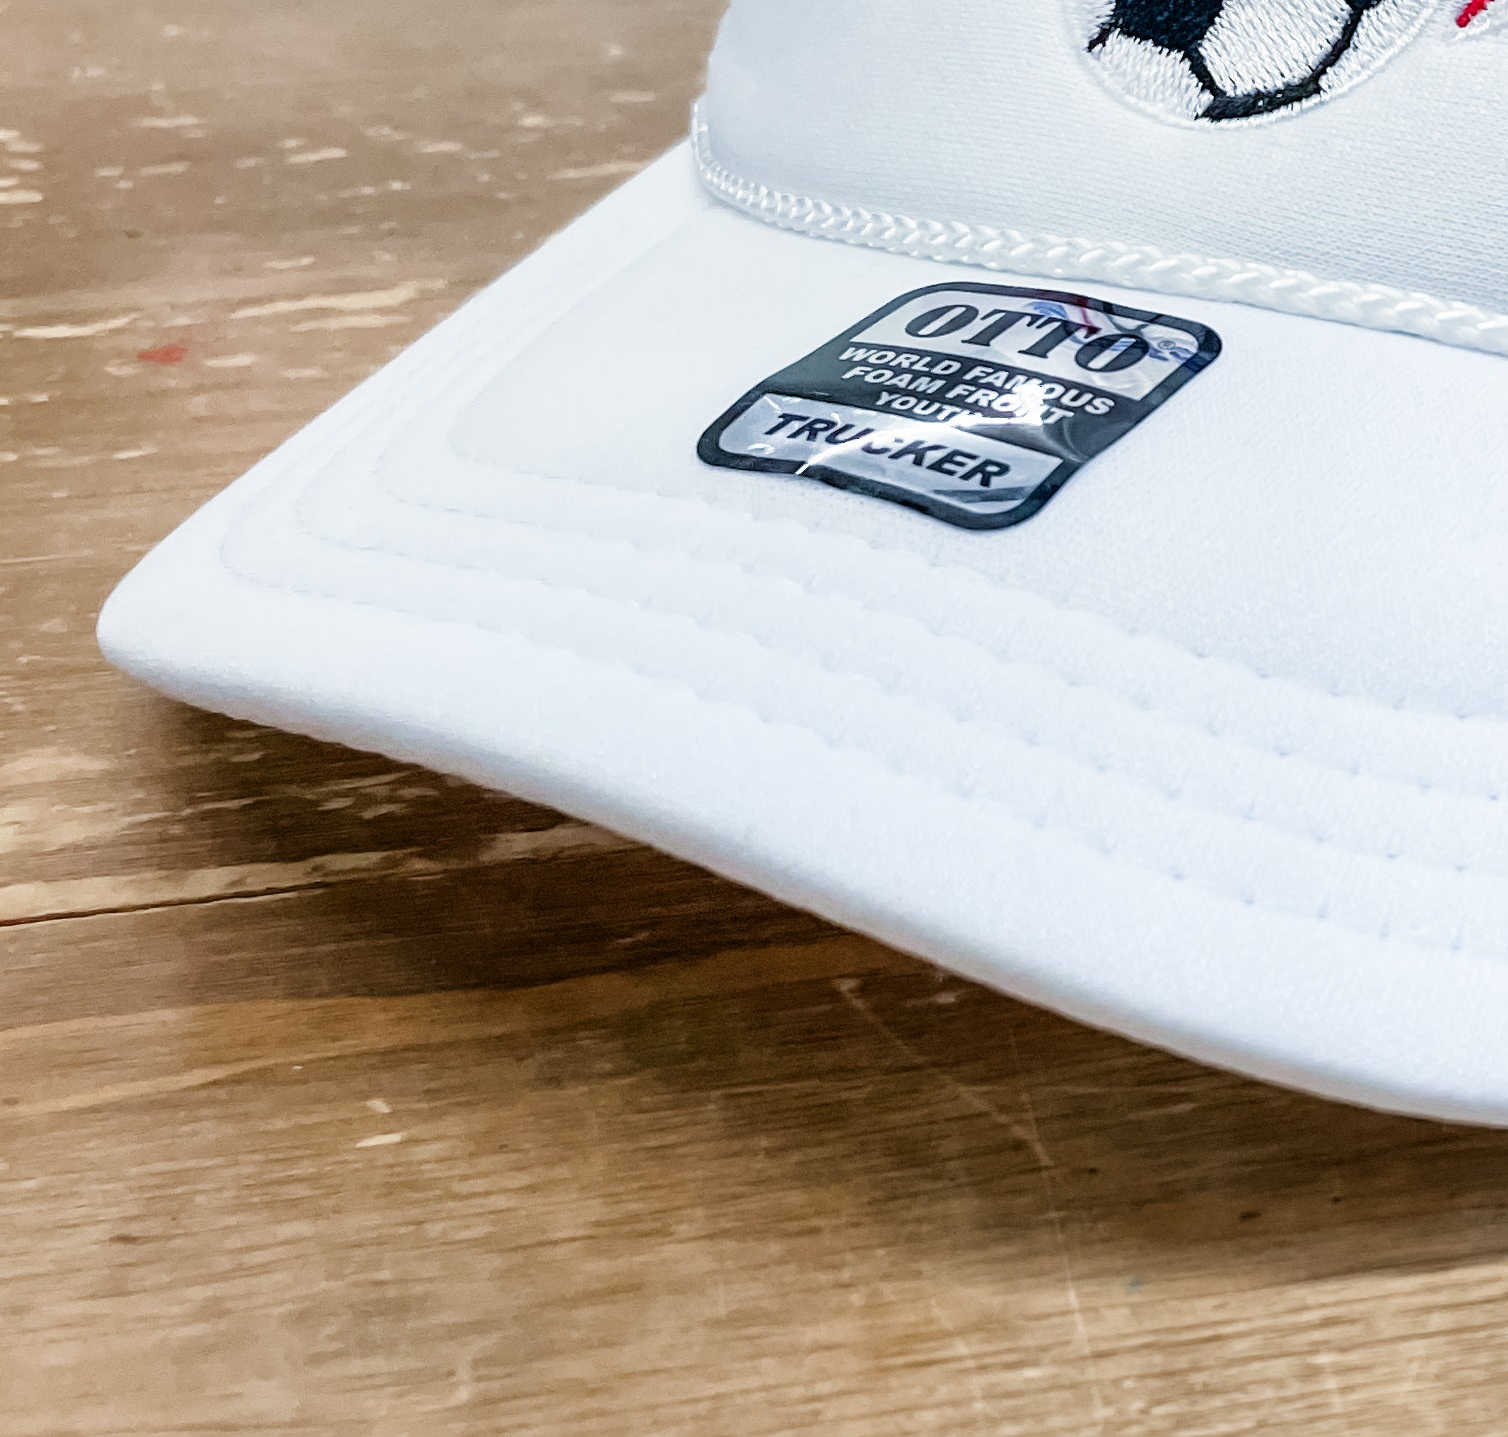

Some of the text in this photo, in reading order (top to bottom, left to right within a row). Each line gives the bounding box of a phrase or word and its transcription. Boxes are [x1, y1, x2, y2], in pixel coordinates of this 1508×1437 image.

[839, 346, 962, 375] WORLD
[904, 304, 1149, 373] OTTO
[842, 366, 1074, 424] FOAM FROT
